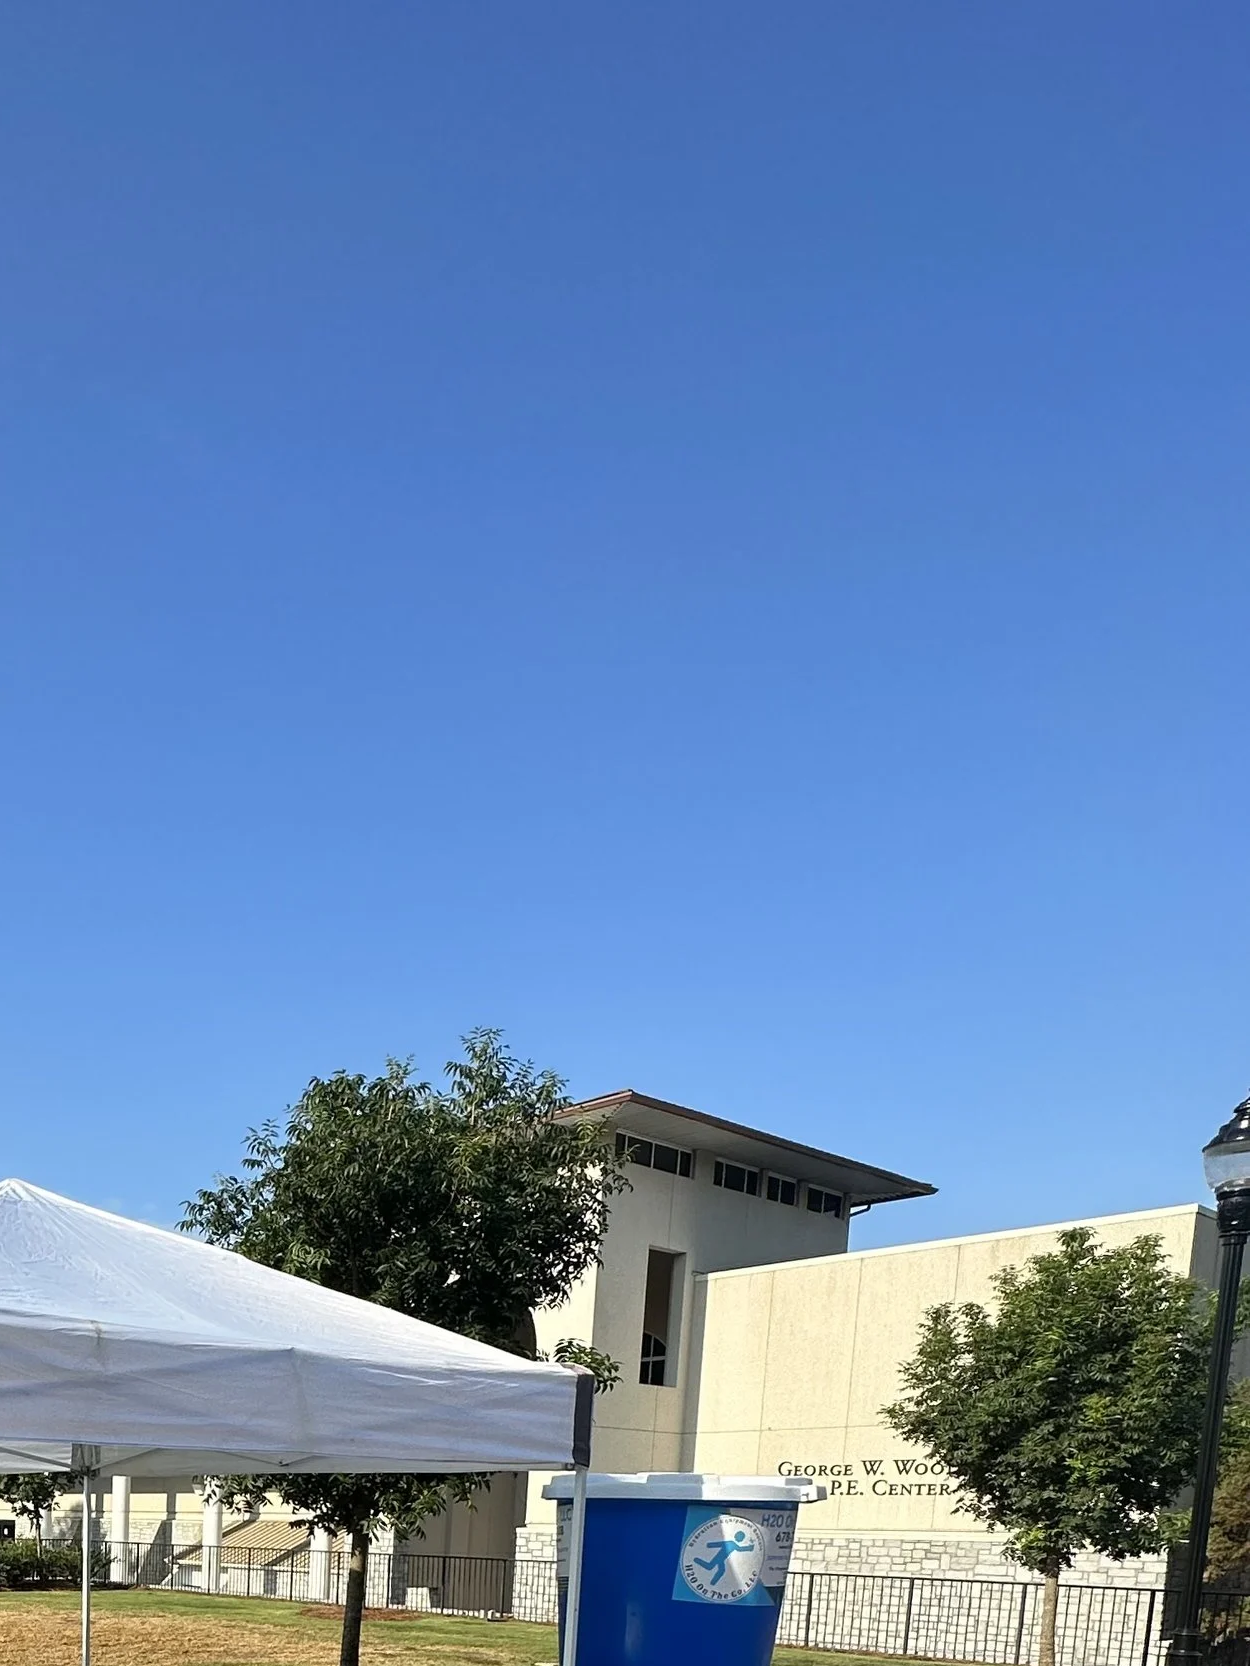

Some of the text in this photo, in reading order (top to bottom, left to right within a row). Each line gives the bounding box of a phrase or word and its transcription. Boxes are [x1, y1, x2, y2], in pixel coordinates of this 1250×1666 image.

[778, 1459, 951, 1476] GEORGE W. WOO
[830, 1479, 951, 1496] P.E. CENTER
[711, 1591, 729, 1600] The
